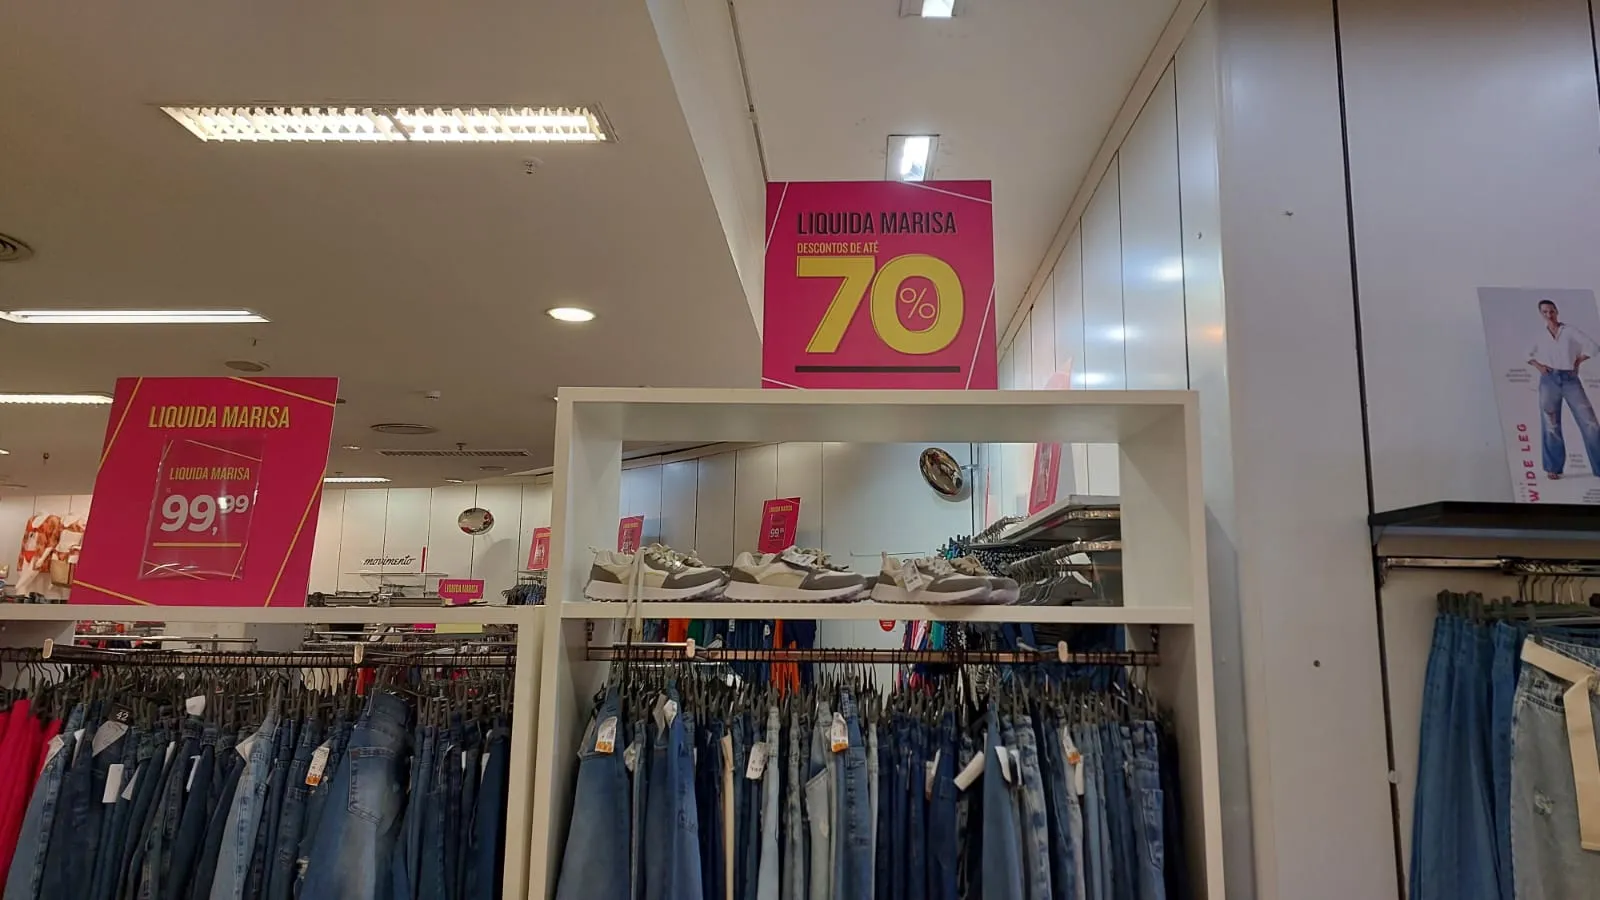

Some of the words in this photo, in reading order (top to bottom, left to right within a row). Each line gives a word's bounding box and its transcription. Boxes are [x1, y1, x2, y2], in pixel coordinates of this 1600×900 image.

[797, 212, 874, 235] LIQUIDA
[880, 211, 957, 234] MARISA
[797, 243, 848, 254] DESCONTOS
[850, 243, 861, 253] DE
[863, 240, 879, 253] ATÉ
[148, 406, 217, 428] LIQUIDA
[221, 406, 290, 428] MARISA
[1517, 423, 1531, 452] LEG
[169, 467, 208, 480] LIQUIDA
[211, 467, 250, 480] MARISA
[1523, 460, 1540, 502] WIDE
